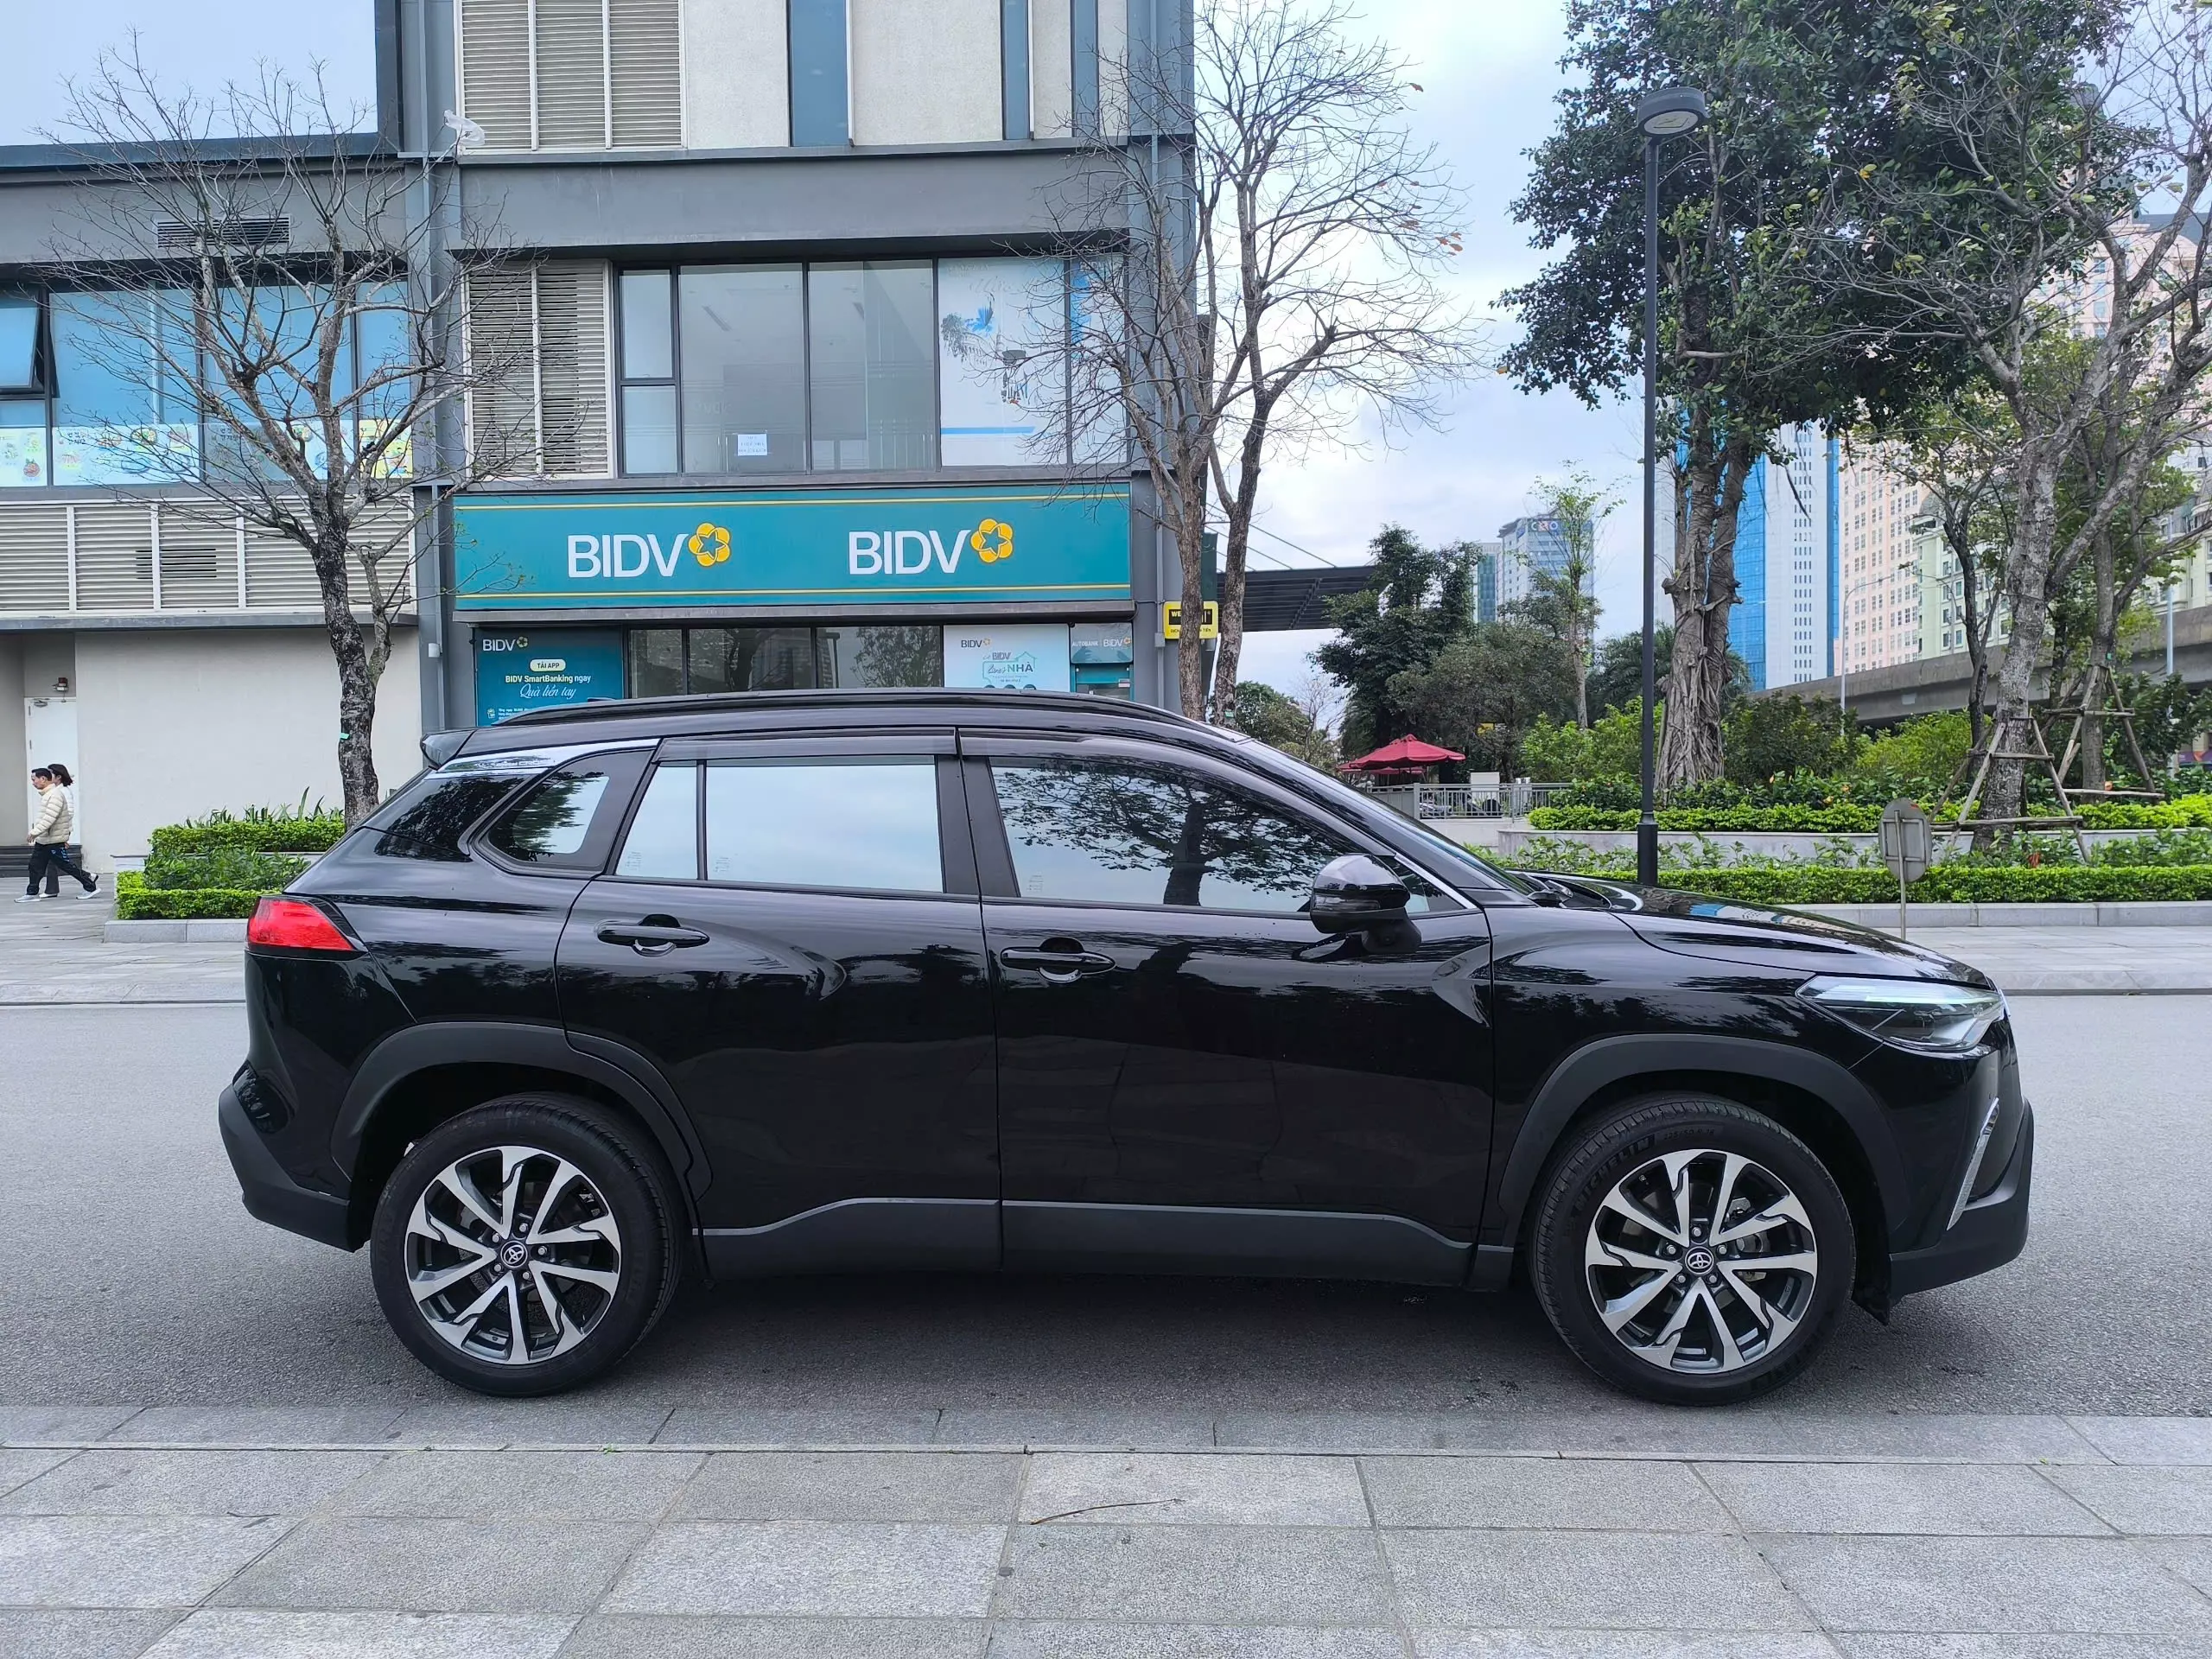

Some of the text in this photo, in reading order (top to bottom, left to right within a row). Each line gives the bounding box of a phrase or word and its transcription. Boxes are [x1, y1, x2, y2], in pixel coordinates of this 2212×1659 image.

[568, 533, 689, 578] BIDV
[849, 530, 971, 575] BIDV
[482, 639, 516, 652] BIDV
[961, 639, 983, 648] BIDV
[1103, 639, 1123, 647] BIDV
[992, 652, 1012, 660] BIDV
[524, 674, 574, 683] SmartBanking
[575, 675, 591, 683] ngay
[519, 683, 540, 699] Quà
[561, 686, 576, 700] tay
[1574, 1137, 1649, 1211] MICHELIN
